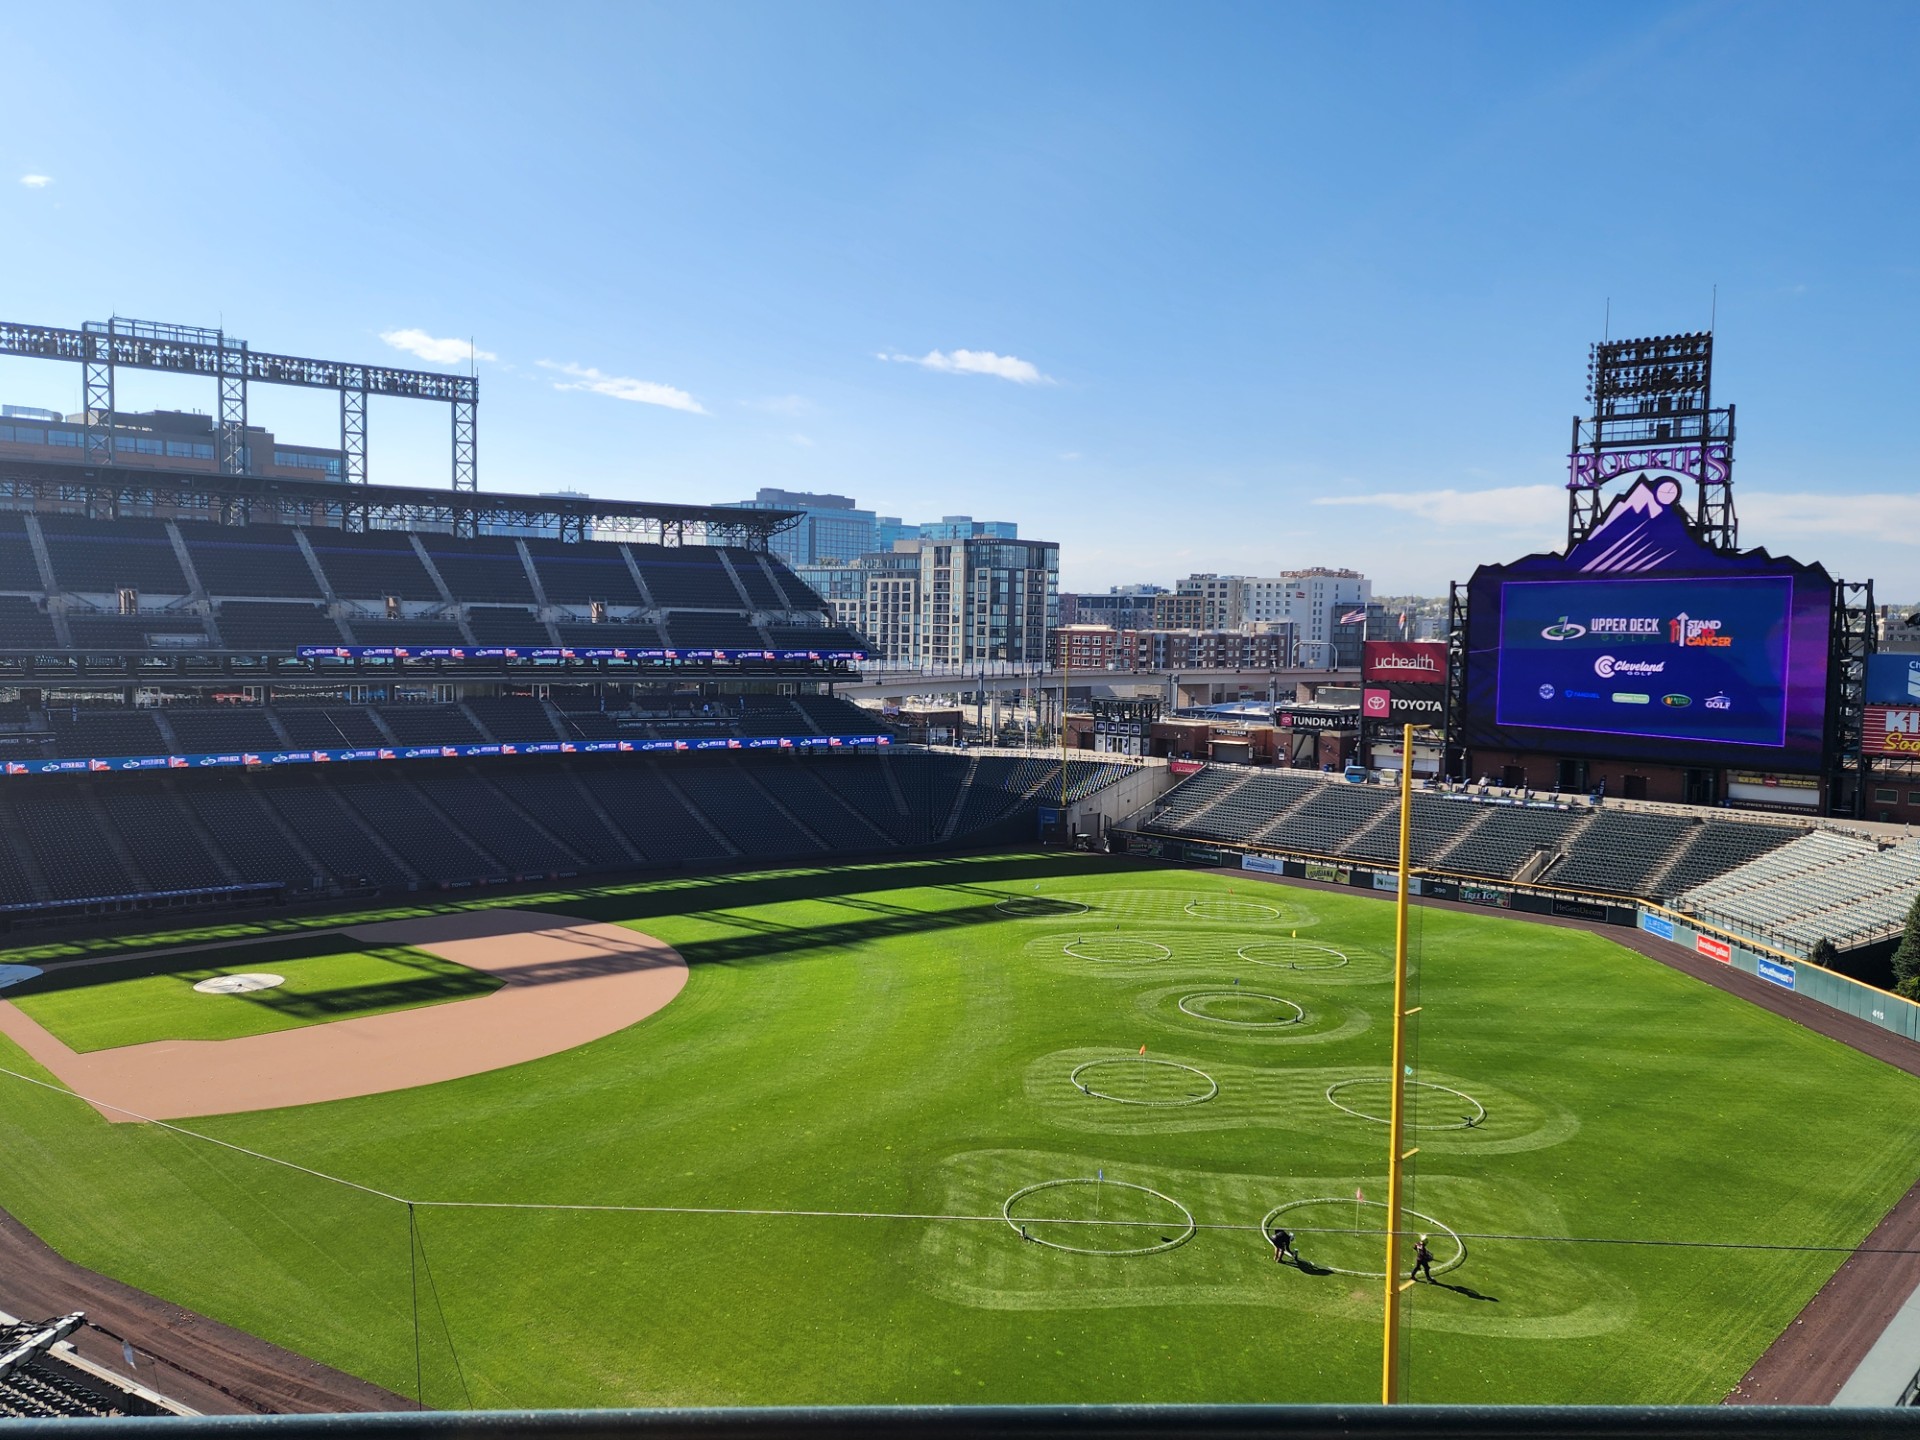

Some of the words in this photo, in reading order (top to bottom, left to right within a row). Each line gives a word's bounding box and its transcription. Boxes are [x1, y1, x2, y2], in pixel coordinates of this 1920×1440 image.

[1565, 445, 1729, 488] ROCKIES
[1591, 618, 1627, 632] UPPER
[1630, 618, 1659, 632] DECK
[1687, 620, 1722, 630] STAND
[1602, 634, 1647, 642] GOLF
[1687, 629, 1701, 637] UP
[1701, 629, 1715, 637] TO
[1686, 636, 1732, 647] CANCER
[1375, 653, 1434, 669] uchealth
[1614, 660, 1664, 672] Cleveland
[1390, 699, 1443, 712] TOYOTA
[1705, 701, 1731, 709] GOLF
[1292, 716, 1334, 727] TUNDRA
[1307, 866, 1333, 877] LOUISIANA
[1464, 890, 1480, 900] TREE
[1556, 904, 1603, 917] HeGetsUs.com
[1760, 964, 1789, 983] Southwest
[1872, 1010, 1884, 1019] 415
